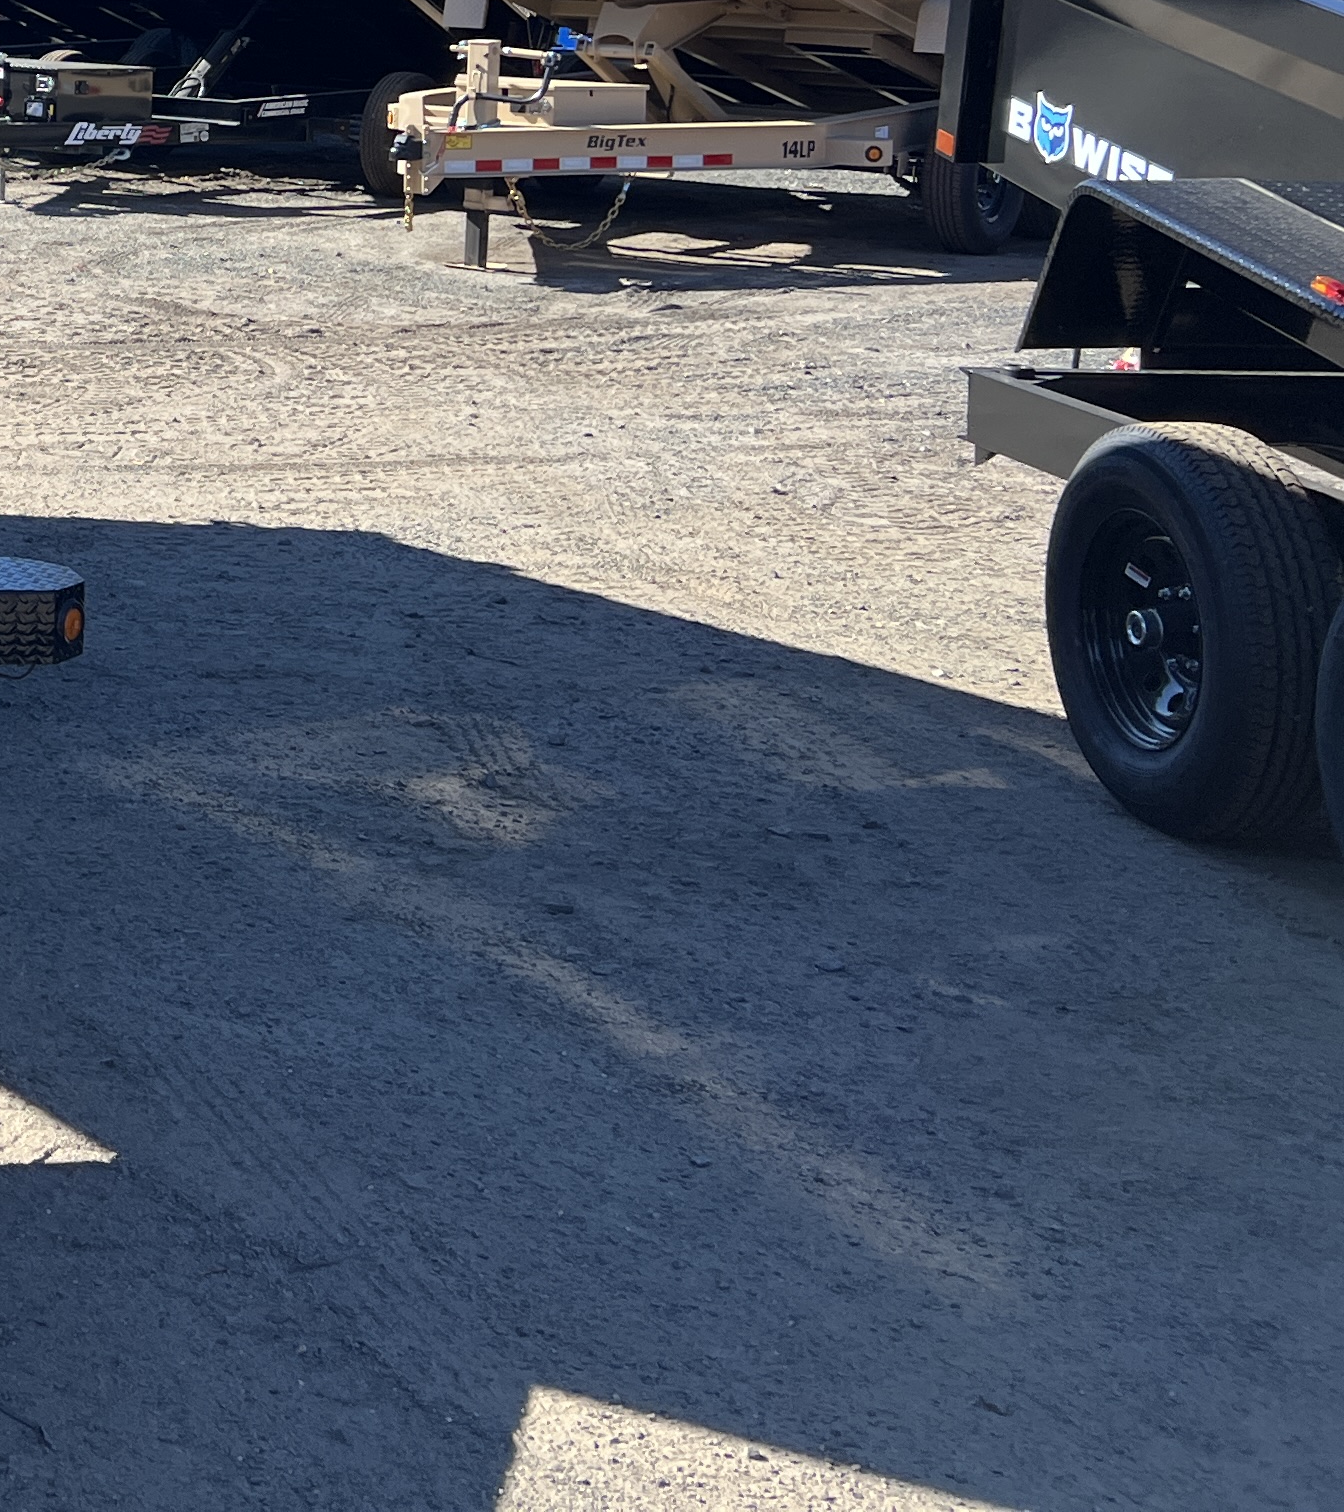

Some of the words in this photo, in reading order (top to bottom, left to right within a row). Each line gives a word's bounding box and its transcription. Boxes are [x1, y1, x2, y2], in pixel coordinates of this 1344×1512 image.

[64, 121, 143, 145] Liberty
[587, 134, 646, 150] BigTex
[782, 140, 816, 158] 14LP
